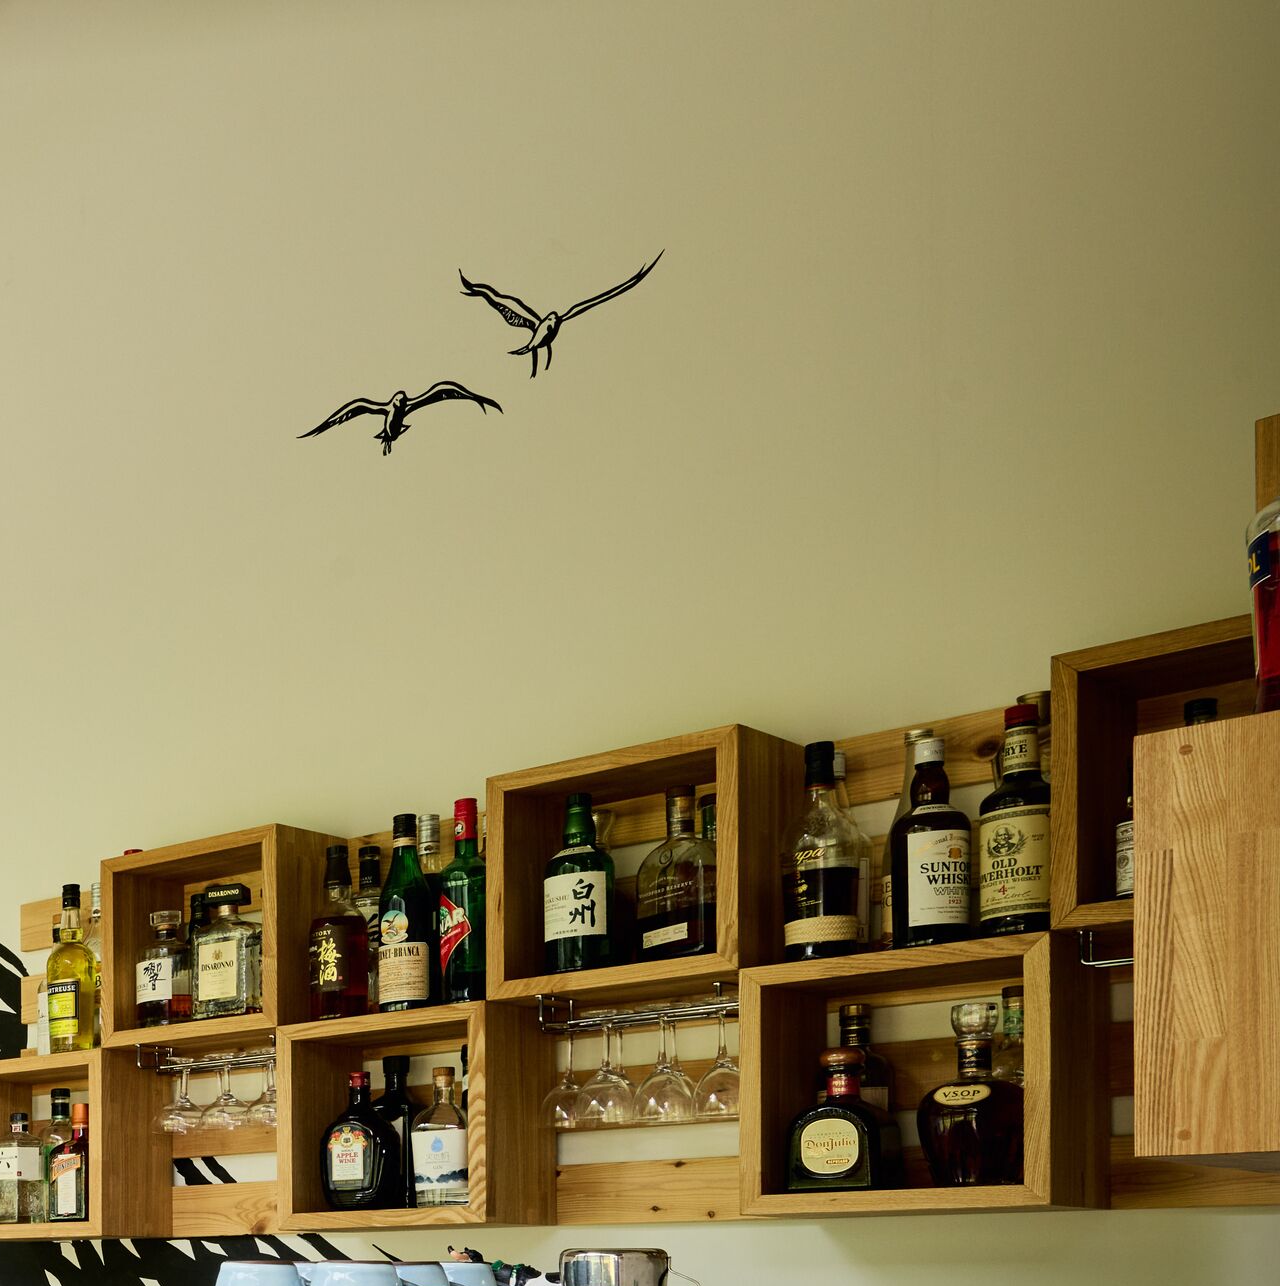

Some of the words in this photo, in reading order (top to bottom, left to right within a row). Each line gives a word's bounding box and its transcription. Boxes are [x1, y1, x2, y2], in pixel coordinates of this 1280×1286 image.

[992, 858, 1017, 870] OLD
[208, 888, 240, 898] DISARONNO
[999, 884, 1008, 896] 4
[568, 878, 597, 928] 白州
[201, 960, 234, 972] DISARONNO
[317, 937, 343, 986] 梅酒
